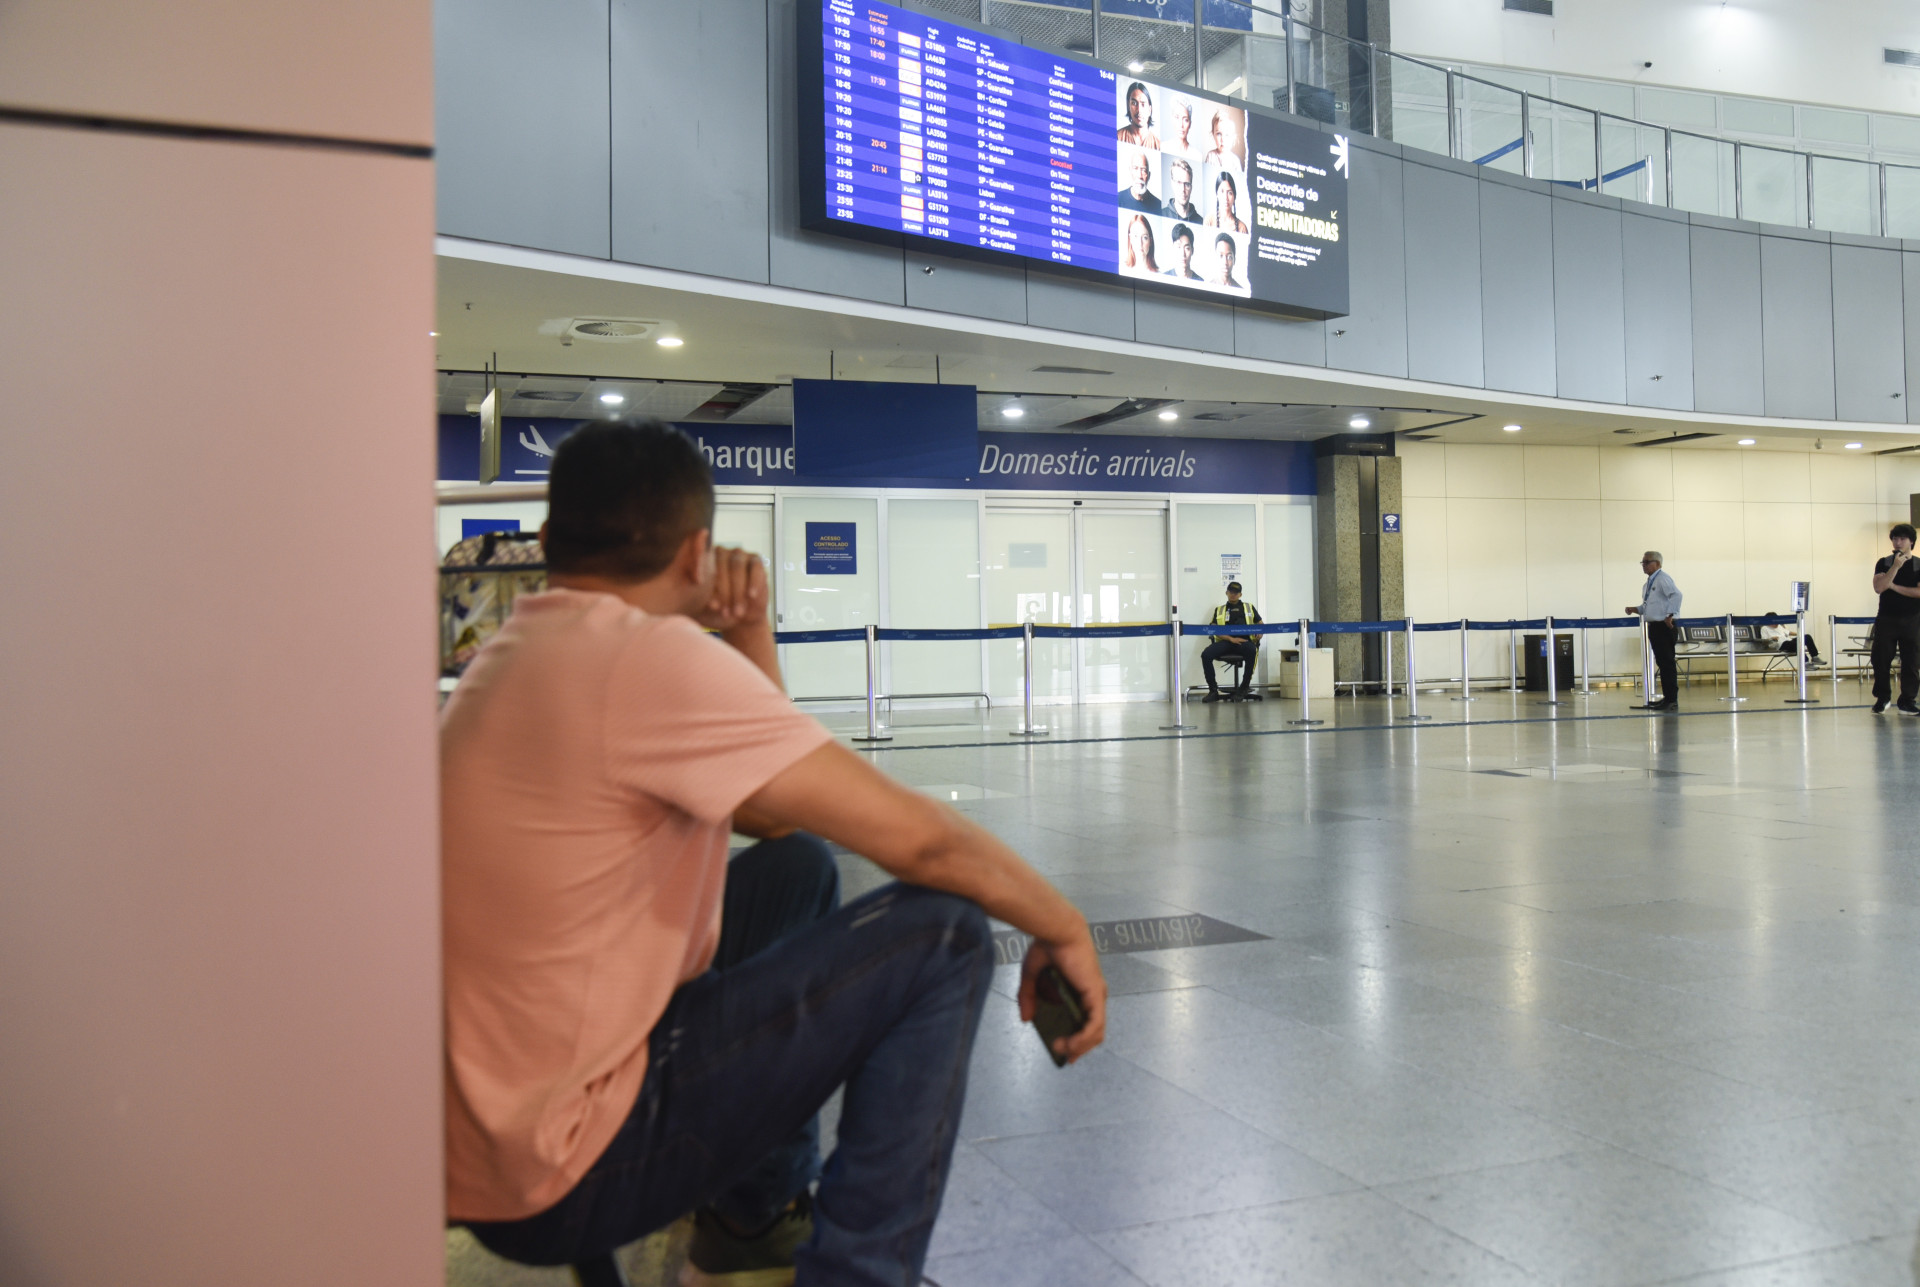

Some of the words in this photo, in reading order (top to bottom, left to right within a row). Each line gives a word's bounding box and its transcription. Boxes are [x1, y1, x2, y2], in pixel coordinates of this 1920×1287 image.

[834, 14, 850, 25] 16:40
[835, 27, 850, 38] 17:25
[870, 24, 885, 35] 16:55
[835, 40, 850, 50] 17:30
[870, 38, 885, 47] 17:40
[835, 54, 850, 64] 17:35
[870, 50, 886, 60] 18:00
[976, 56, 984, 64] BA
[987, 59, 1009, 71] Salvador
[835, 66, 851, 77] 17:40
[1100, 70, 1114, 80] 16:44
[836, 79, 851, 89] 18:45
[870, 76, 886, 86] 17:30
[1049, 77, 1073, 90] Confirmed
[836, 92, 852, 102] 19:20
[1049, 89, 1073, 101] Confirmed
[836, 105, 852, 115] 19:20
[977, 104, 984, 112] RJ
[1049, 100, 1073, 112] Confirmed
[836, 118, 852, 128] 19:40
[1050, 112, 1073, 124] Confirmed
[836, 130, 852, 140] 20:15
[978, 128, 984, 136] PE
[988, 131, 1004, 141] Recife
[1050, 124, 1074, 136] Confirmed
[872, 139, 886, 149] 20:45
[1050, 136, 1073, 147] Confirmed
[836, 143, 852, 154] 21:30
[1057, 148, 1069, 158] Time
[836, 156, 852, 166] 21:45
[978, 152, 985, 160] PA
[836, 169, 852, 179] 23:25
[872, 164, 887, 174] 21:14
[978, 165, 994, 174] Miami
[1058, 172, 1070, 180] Time
[837, 183, 853, 193] 23:30
[1051, 182, 1074, 193] Confirmed
[1257, 176, 1304, 198] Desconfie
[1306, 188, 1318, 201] de
[837, 196, 853, 206] 23:55
[1058, 194, 1070, 204] Time
[1257, 192, 1304, 212] propostas
[838, 209, 853, 218] 23:55
[1058, 206, 1070, 215] Time
[1058, 218, 1070, 226] Time
[1257, 206, 1339, 242] ENCANTADORAS
[1059, 230, 1070, 238] Time
[1059, 242, 1071, 250] Time
[1060, 253, 1071, 261] Time
[979, 445, 1099, 475] Domestic
[1107, 450, 1196, 477] arrivals
